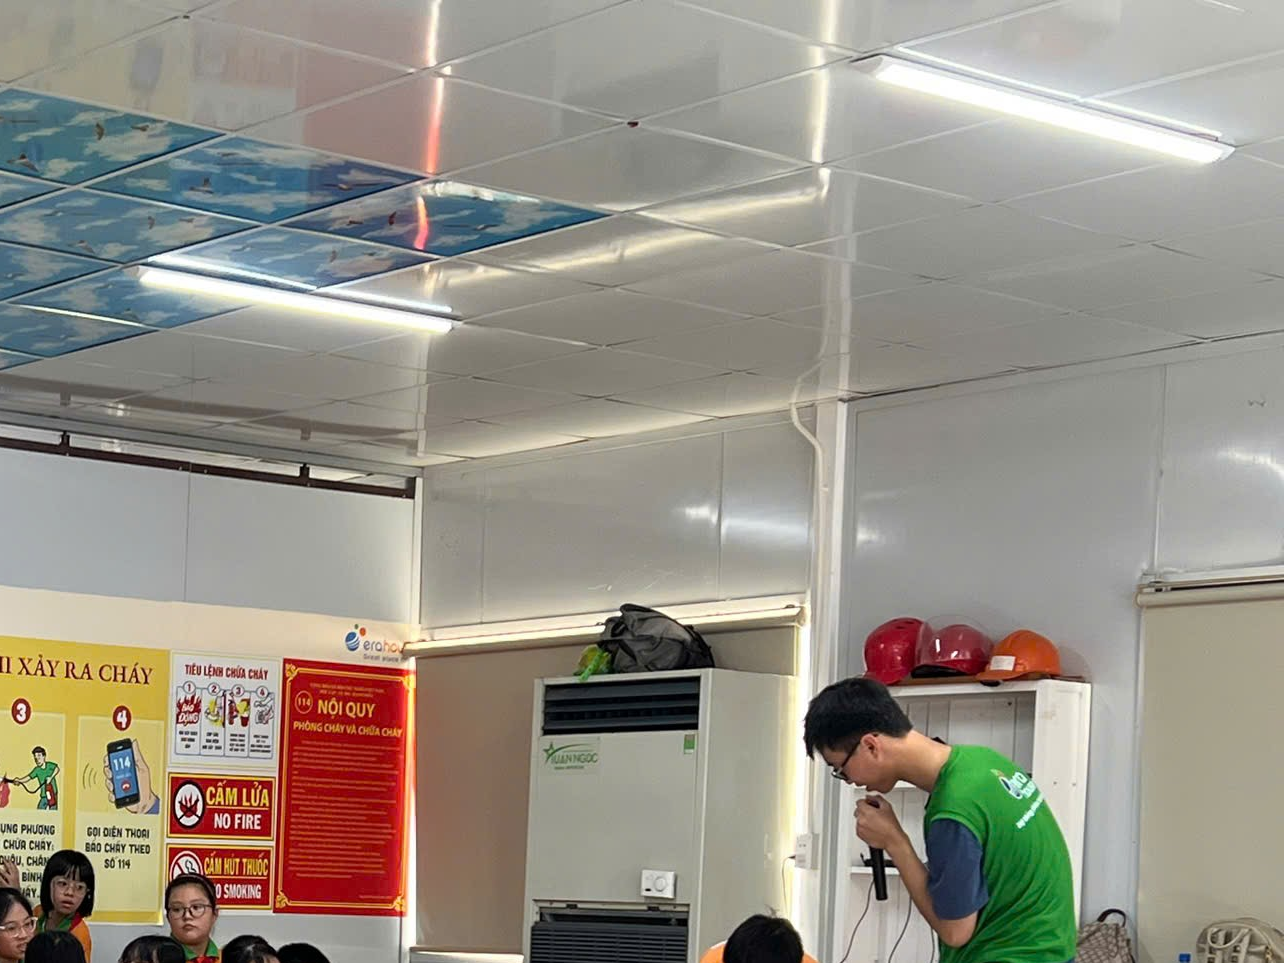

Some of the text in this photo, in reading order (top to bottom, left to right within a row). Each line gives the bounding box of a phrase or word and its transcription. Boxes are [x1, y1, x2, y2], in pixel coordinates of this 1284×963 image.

[18, 654, 60, 678] XẢY
[65, 661, 93, 680] RA
[98, 662, 153, 685] CHÁY
[185, 663, 268, 680] TIÊU LỆNH CHỮA CHÁY
[211, 685, 217, 693] 2
[236, 687, 241, 695] 3
[259, 688, 265, 696] 4
[298, 698, 311, 706] 114
[317, 697, 375, 719] NỘI QUY
[16, 703, 27, 722] 3
[116, 710, 128, 728] 4
[293, 720, 323, 732] PHÒNG
[324, 722, 345, 734] CHÁY
[346, 723, 357, 734] VÀ
[358, 724, 380, 736] CHỮA
[113, 756, 131, 771] 114
[206, 780, 269, 807] CẤM LỬA
[214, 813, 262, 830] NO FIRE
[21, 824, 55, 835] PHƯƠNG
[87, 825, 150, 841] GỌI ĐIỆN THOẠI
[3, 838, 27, 850] CHỮA
[85, 839, 151, 854] BÁO CHÁY THEO
[104, 856, 131, 869] SỐ 114
[204, 851, 269, 876] CẤM HÚT THUỐC
[22, 869, 42, 882] BÌNH
[223, 884, 262, 899] SMOKING
